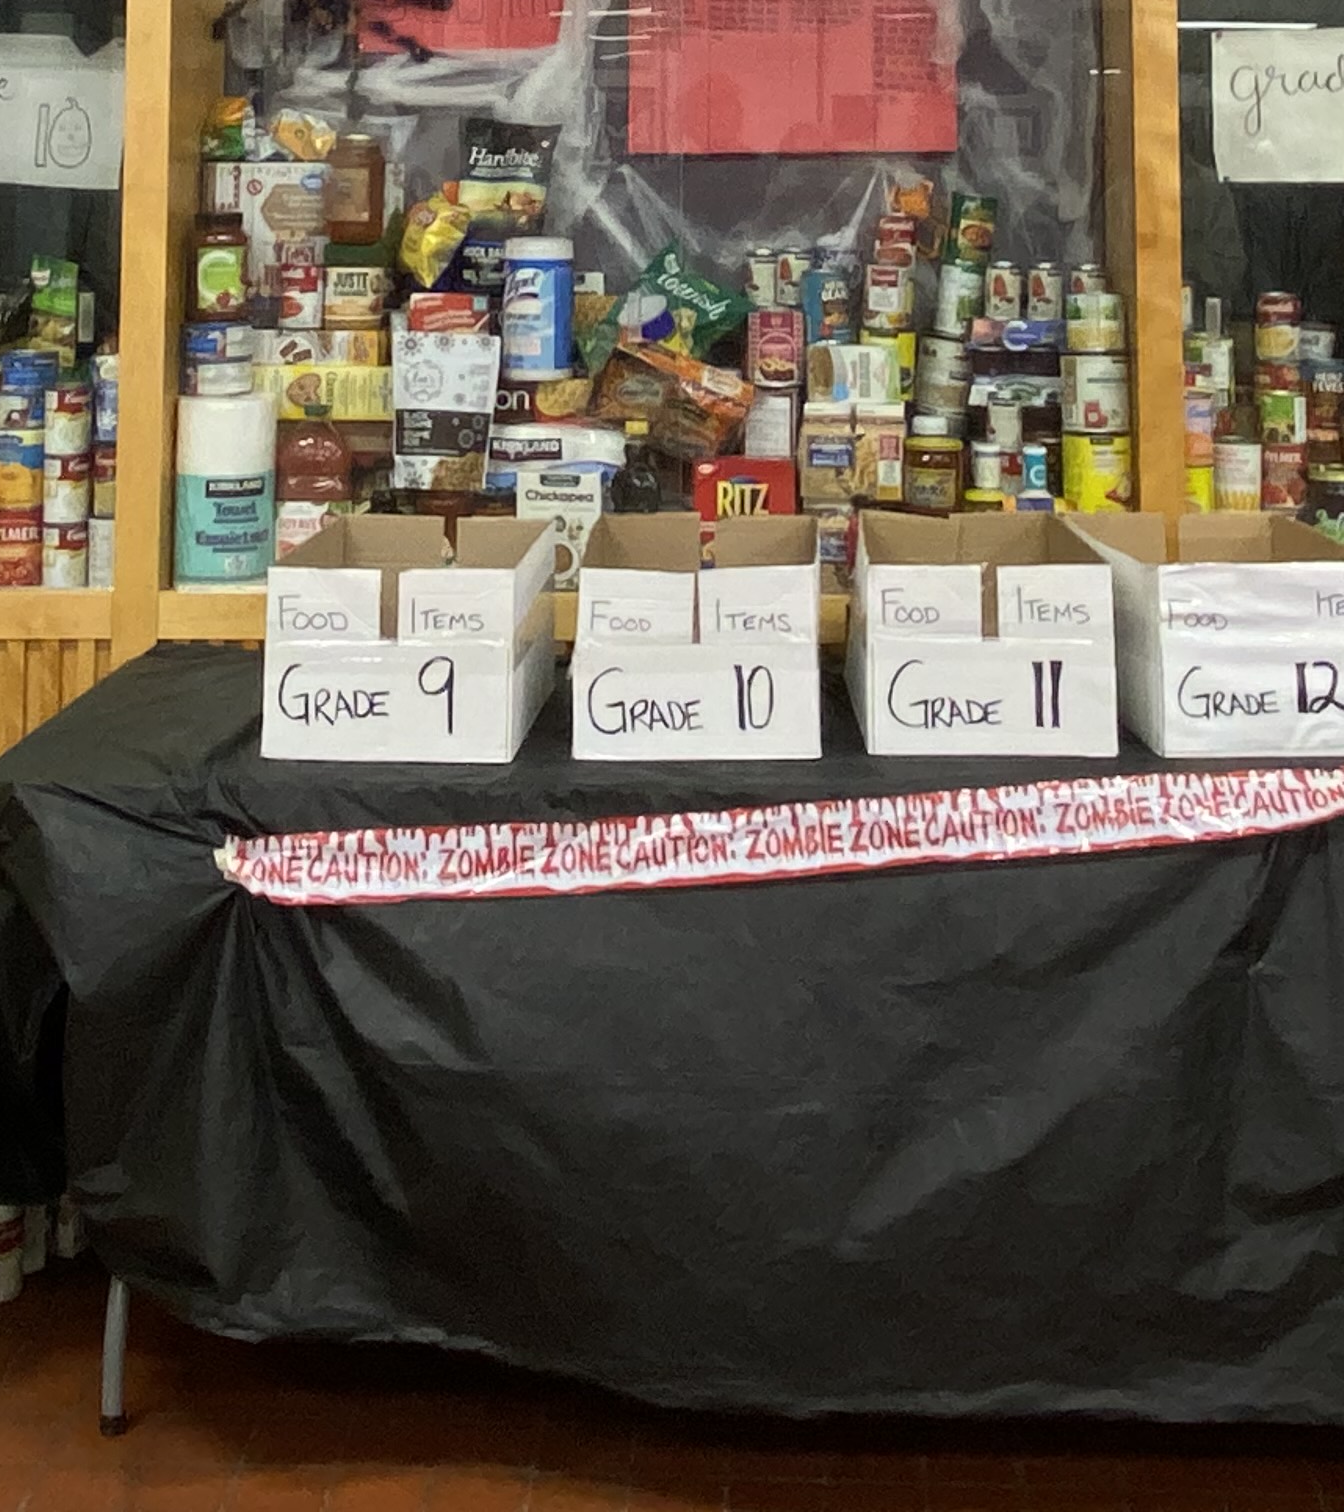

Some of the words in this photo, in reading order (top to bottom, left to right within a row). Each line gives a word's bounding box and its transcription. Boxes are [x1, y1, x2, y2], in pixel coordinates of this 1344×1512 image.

[493, 438, 560, 453] KIRKLAND
[525, 489, 594, 503] Chickapea
[716, 480, 769, 516] RITZ
[278, 663, 391, 727] GRADE
[418, 655, 455, 735] 9
[587, 666, 705, 735] GRADE
[734, 664, 774, 732] 10
[887, 658, 1003, 729] GRADE
[1032, 659, 1064, 729] 11
[1177, 665, 1281, 719] GRADE
[744, 822, 845, 862] ZOMBIE
[848, 819, 921, 853] ZONE
